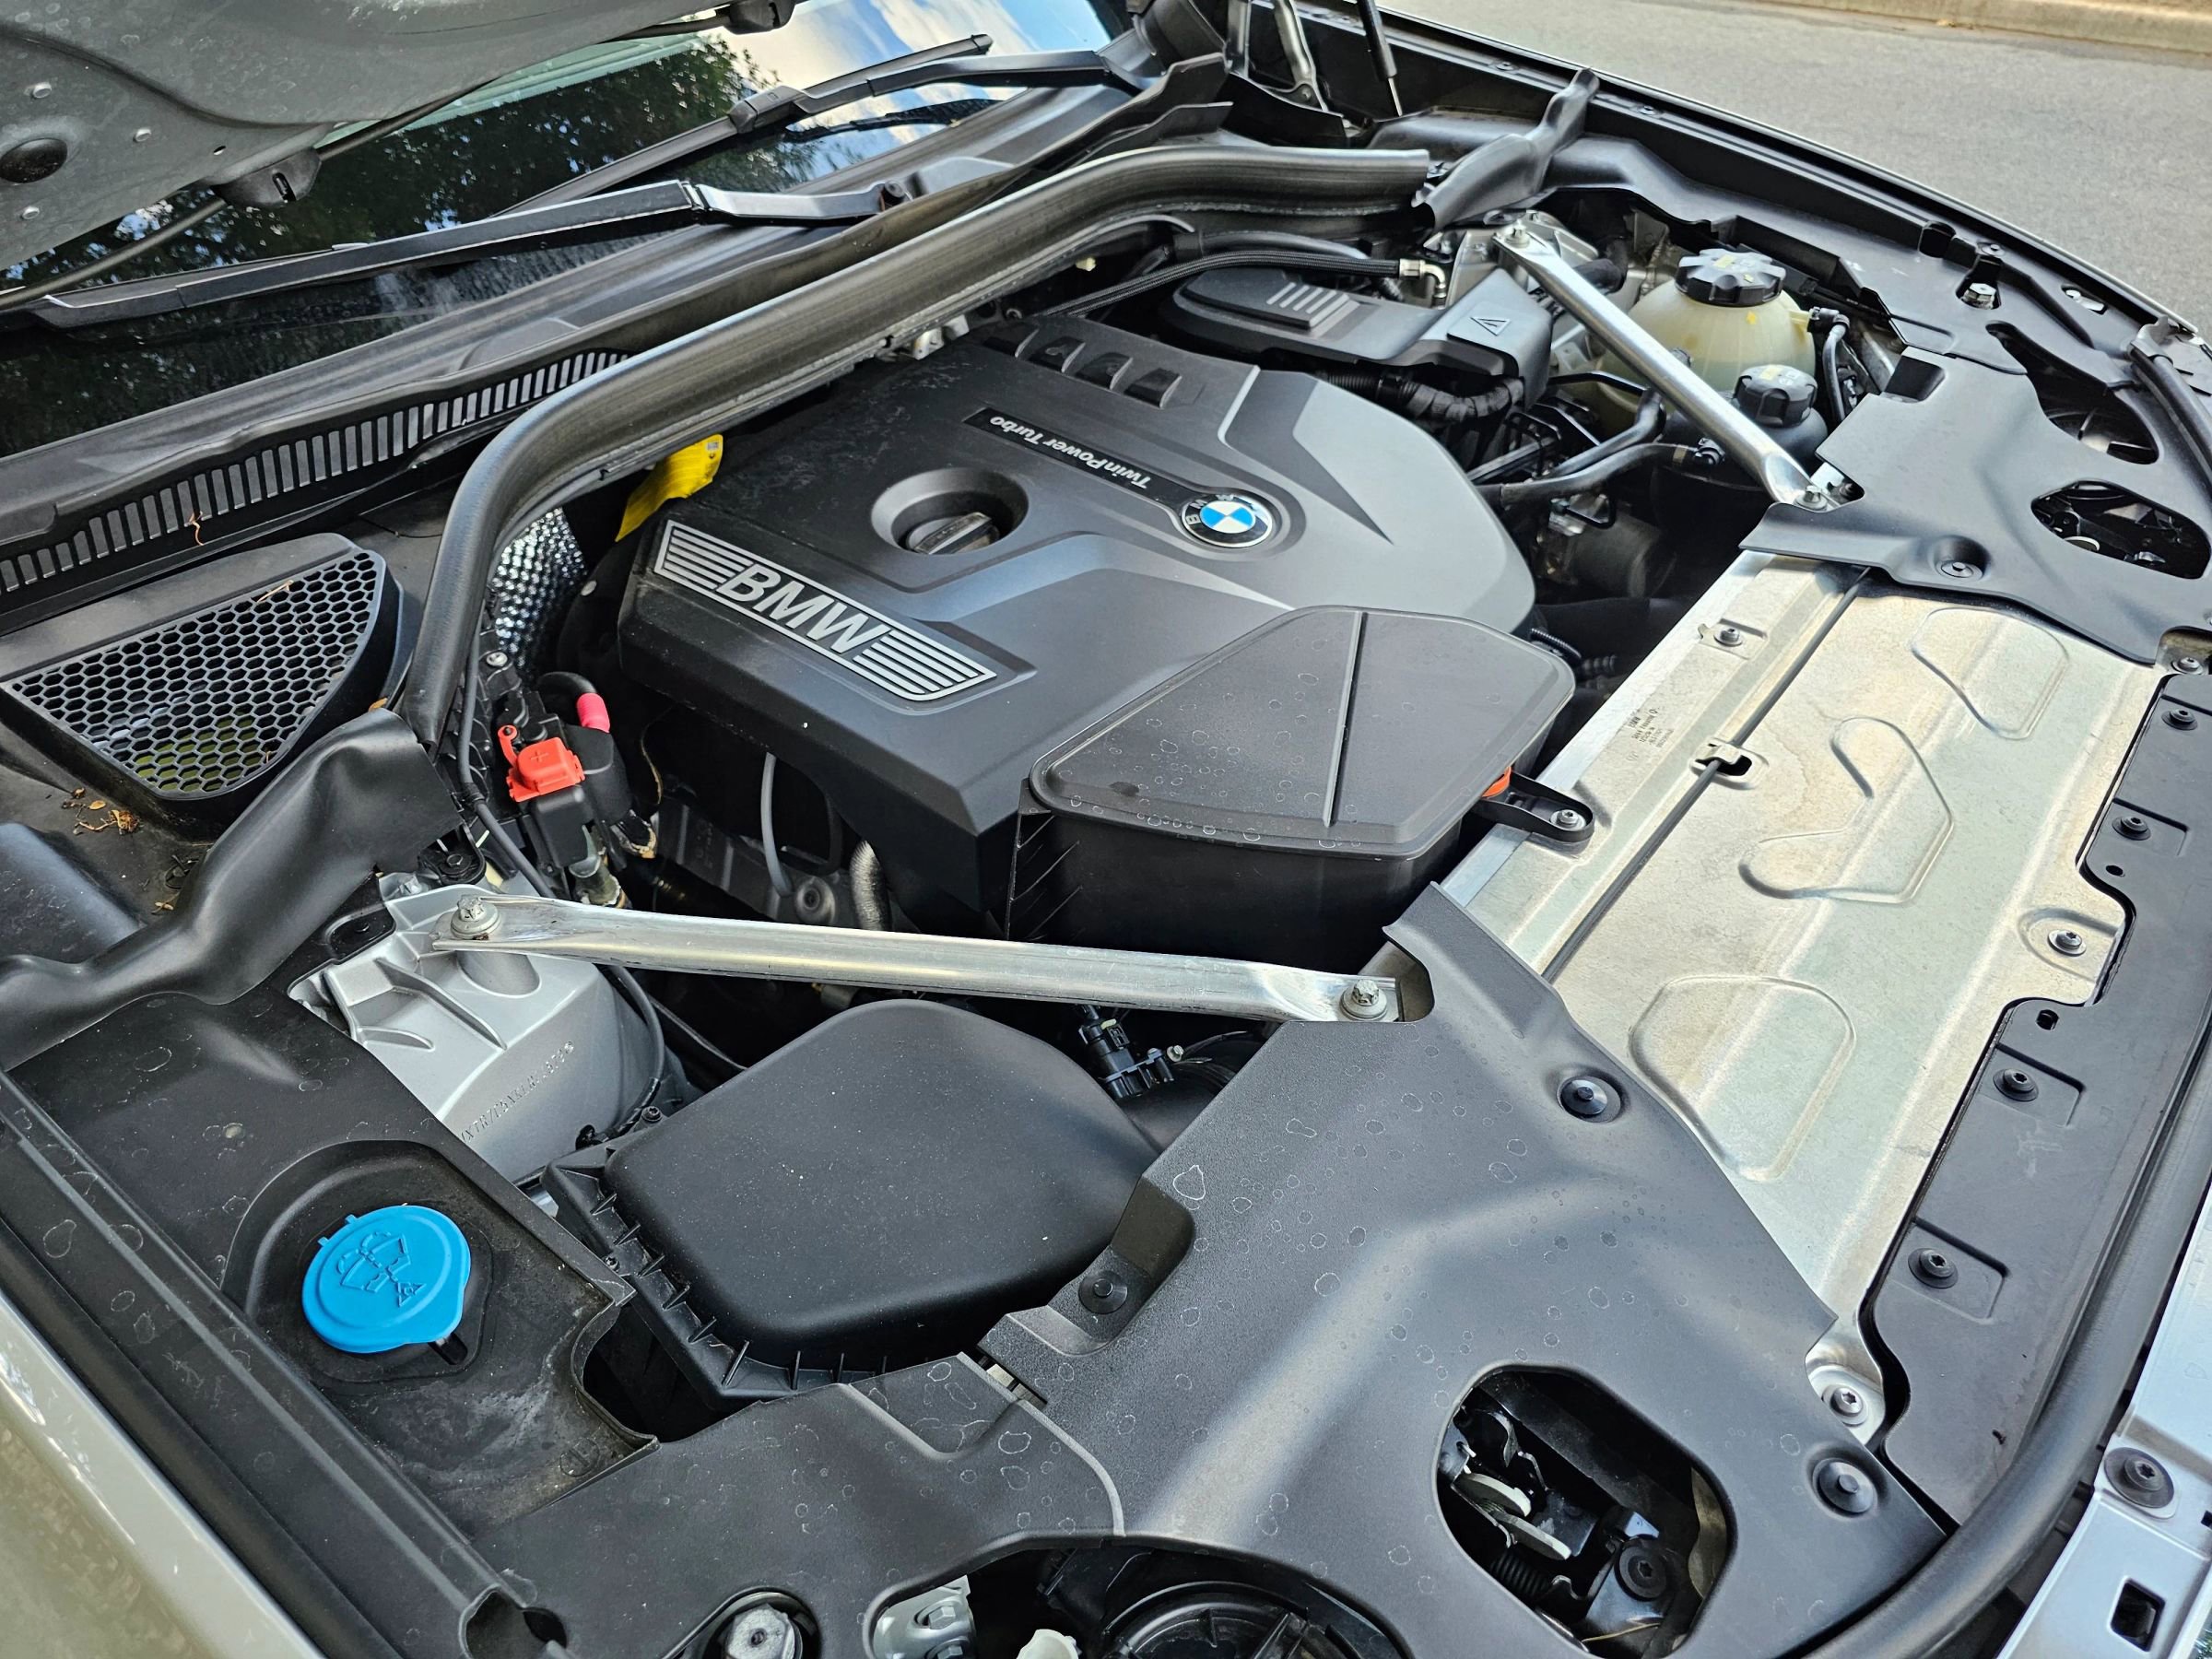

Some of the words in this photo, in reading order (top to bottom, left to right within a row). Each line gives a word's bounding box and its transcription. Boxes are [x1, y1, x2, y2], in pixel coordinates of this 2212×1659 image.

[990, 416, 1044, 445] Turbo
[1042, 439, 1151, 489] TwinPower
[1186, 493, 1236, 525] BMW
[716, 563, 891, 653] BMW
